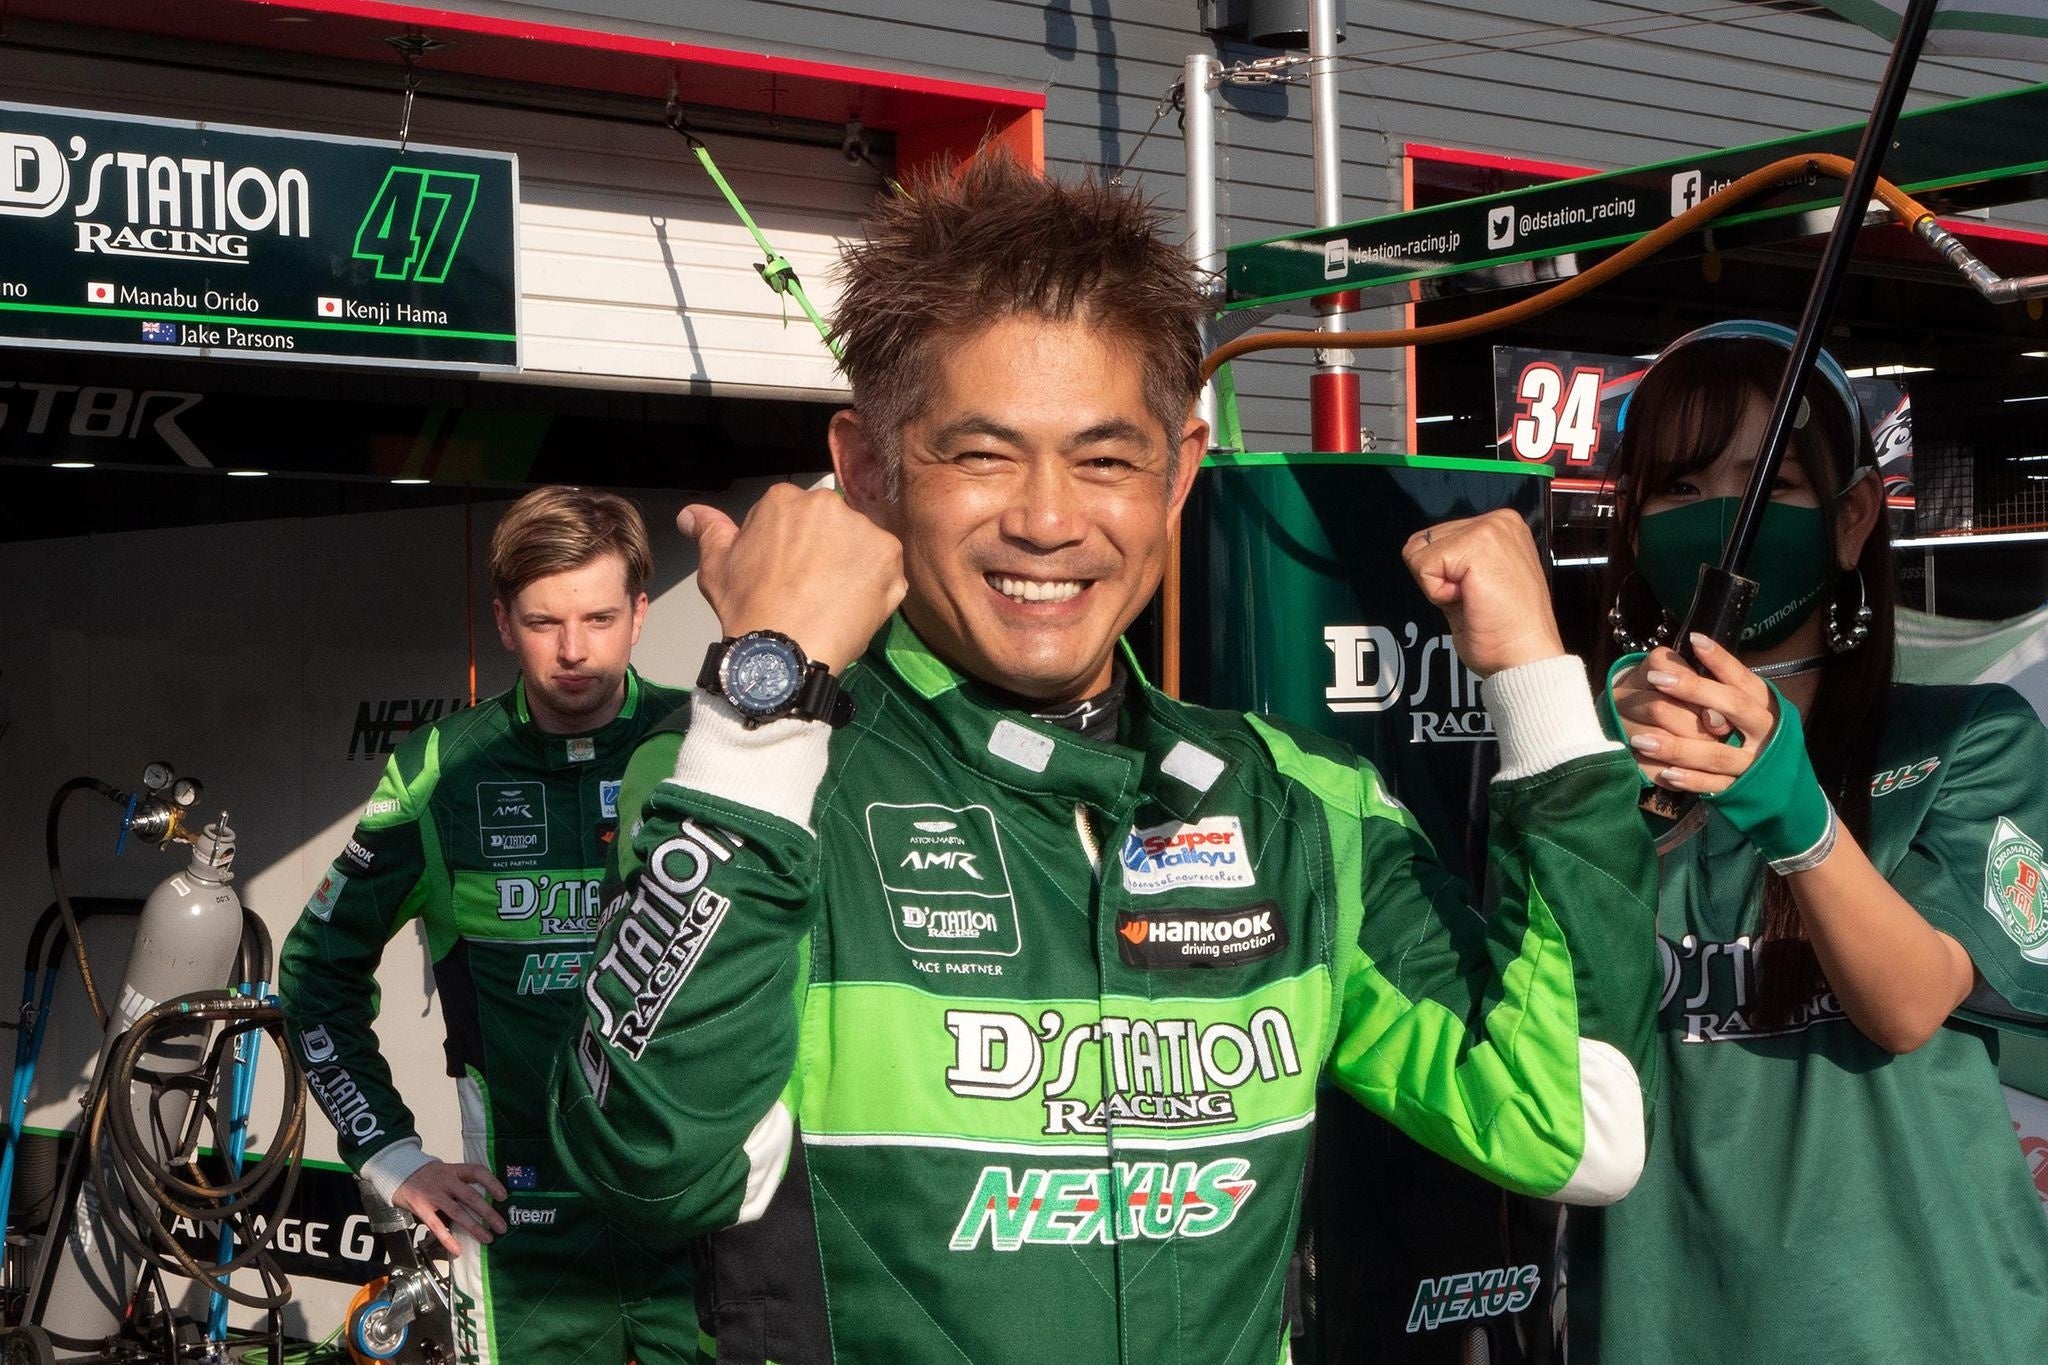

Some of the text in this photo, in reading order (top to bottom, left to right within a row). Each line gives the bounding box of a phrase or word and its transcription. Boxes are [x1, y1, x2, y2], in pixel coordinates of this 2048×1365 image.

[351, 165, 481, 284] 47
[1519, 196, 1636, 236] @dstation_racing
[74, 221, 250, 262] RACING
[1353, 231, 1461, 266] dstation-racing.jp
[120, 285, 260, 313] Manabu Orido
[345, 299, 449, 326] Kenji Hama
[179, 323, 295, 350] Jake Parsons
[0, 381, 214, 469] T8R
[1513, 363, 1603, 464] 34
[1143, 831, 1235, 855] Super
[1149, 847, 1237, 869] Taikyu
[1993, 845, 2040, 869] DRAMATIC
[900, 851, 984, 880] AMR
[901, 906, 998, 933] D'STATION
[928, 928, 980, 938] RACING
[1181, 932, 1276, 958] driving emotion
[608, 886, 731, 1063] RACING
[911, 959, 1004, 976] RACE PARTNER
[945, 1006, 1303, 1100] D'STATION
[306, 1069, 349, 1138] RACING
[1042, 1090, 1238, 1136] RACING
[507, 1204, 557, 1225] freem
[949, 1156, 1258, 1252] NEXUS
[1406, 1264, 1541, 1333] NEXUS
